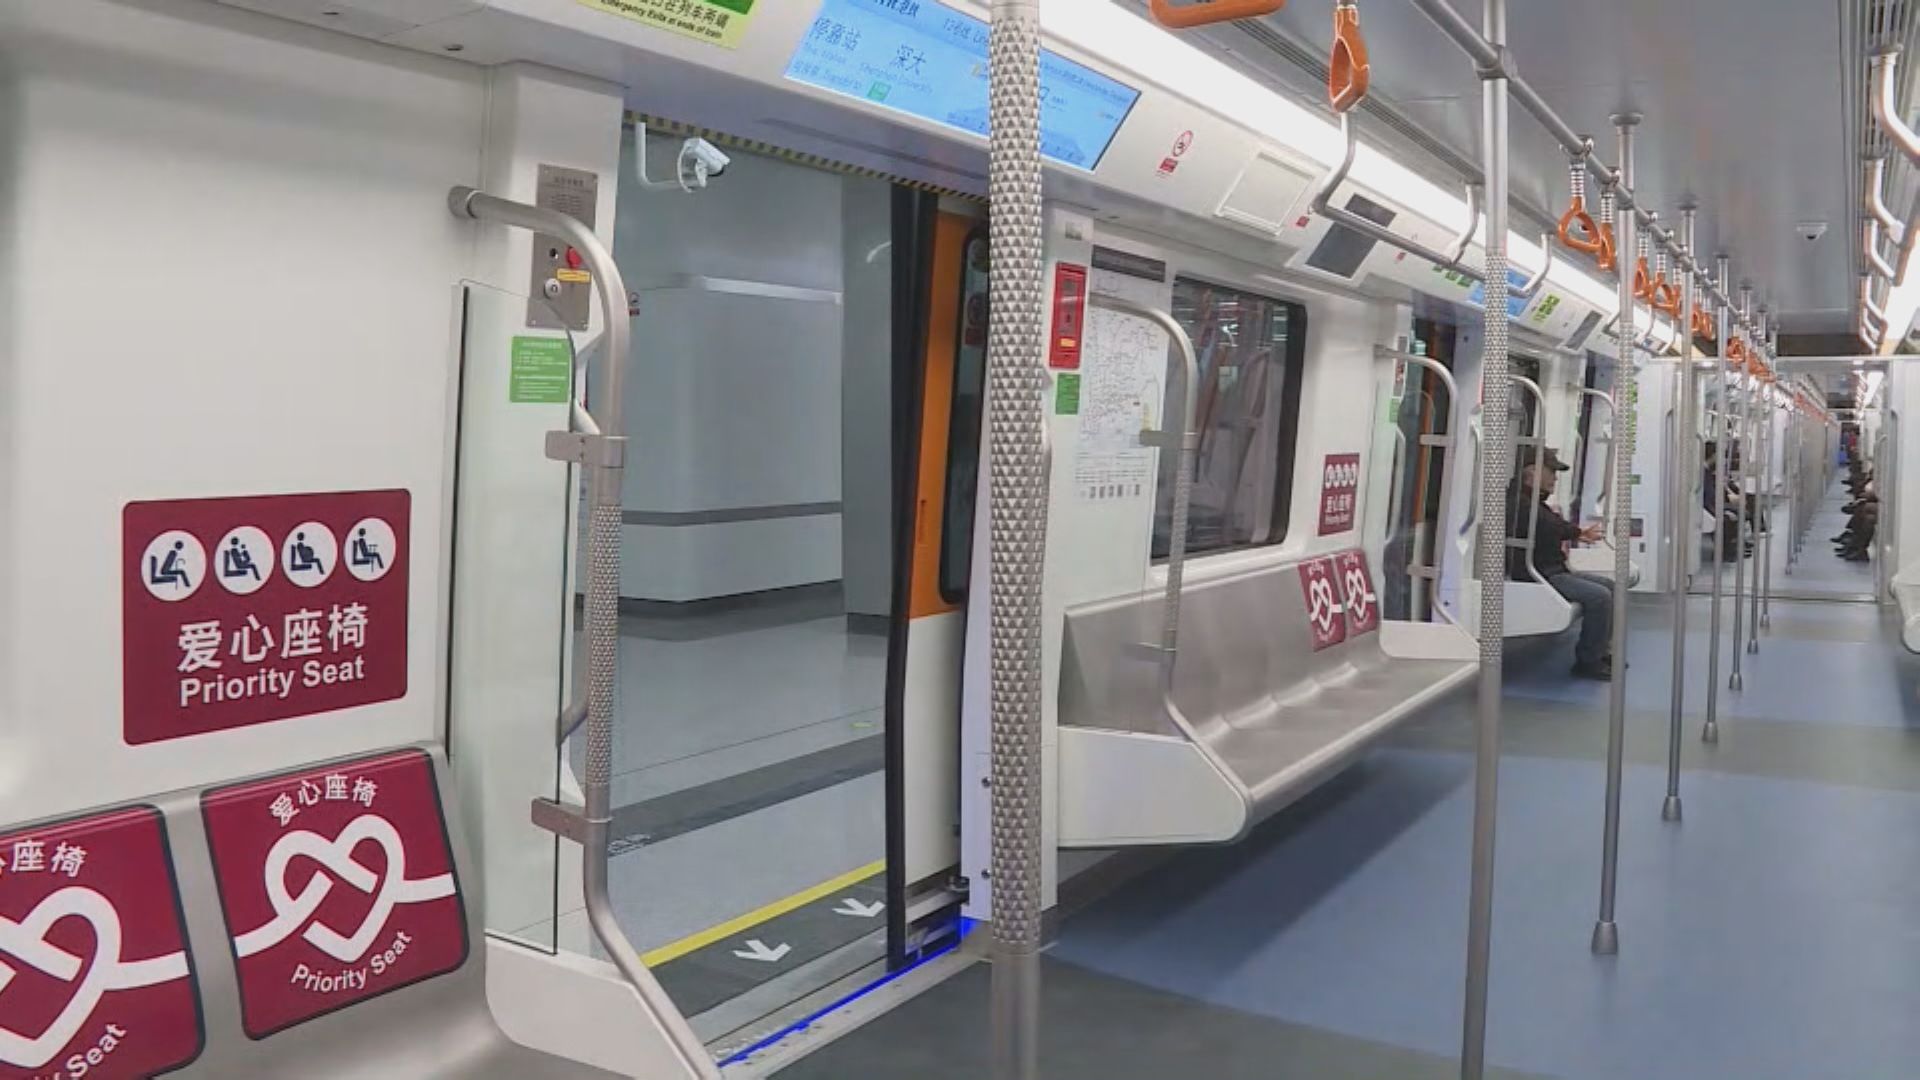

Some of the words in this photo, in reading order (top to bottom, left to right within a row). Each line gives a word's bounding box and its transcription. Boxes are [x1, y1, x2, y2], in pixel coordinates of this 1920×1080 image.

[178, 602, 369, 673] 爱心座椅
[180, 668, 294, 707] Priority
[302, 655, 365, 688] Seat
[269, 774, 379, 828] 爱心座椅
[291, 963, 367, 993] Priority
[371, 930, 413, 976] Seat
[66, 1023, 127, 1079] Seat
